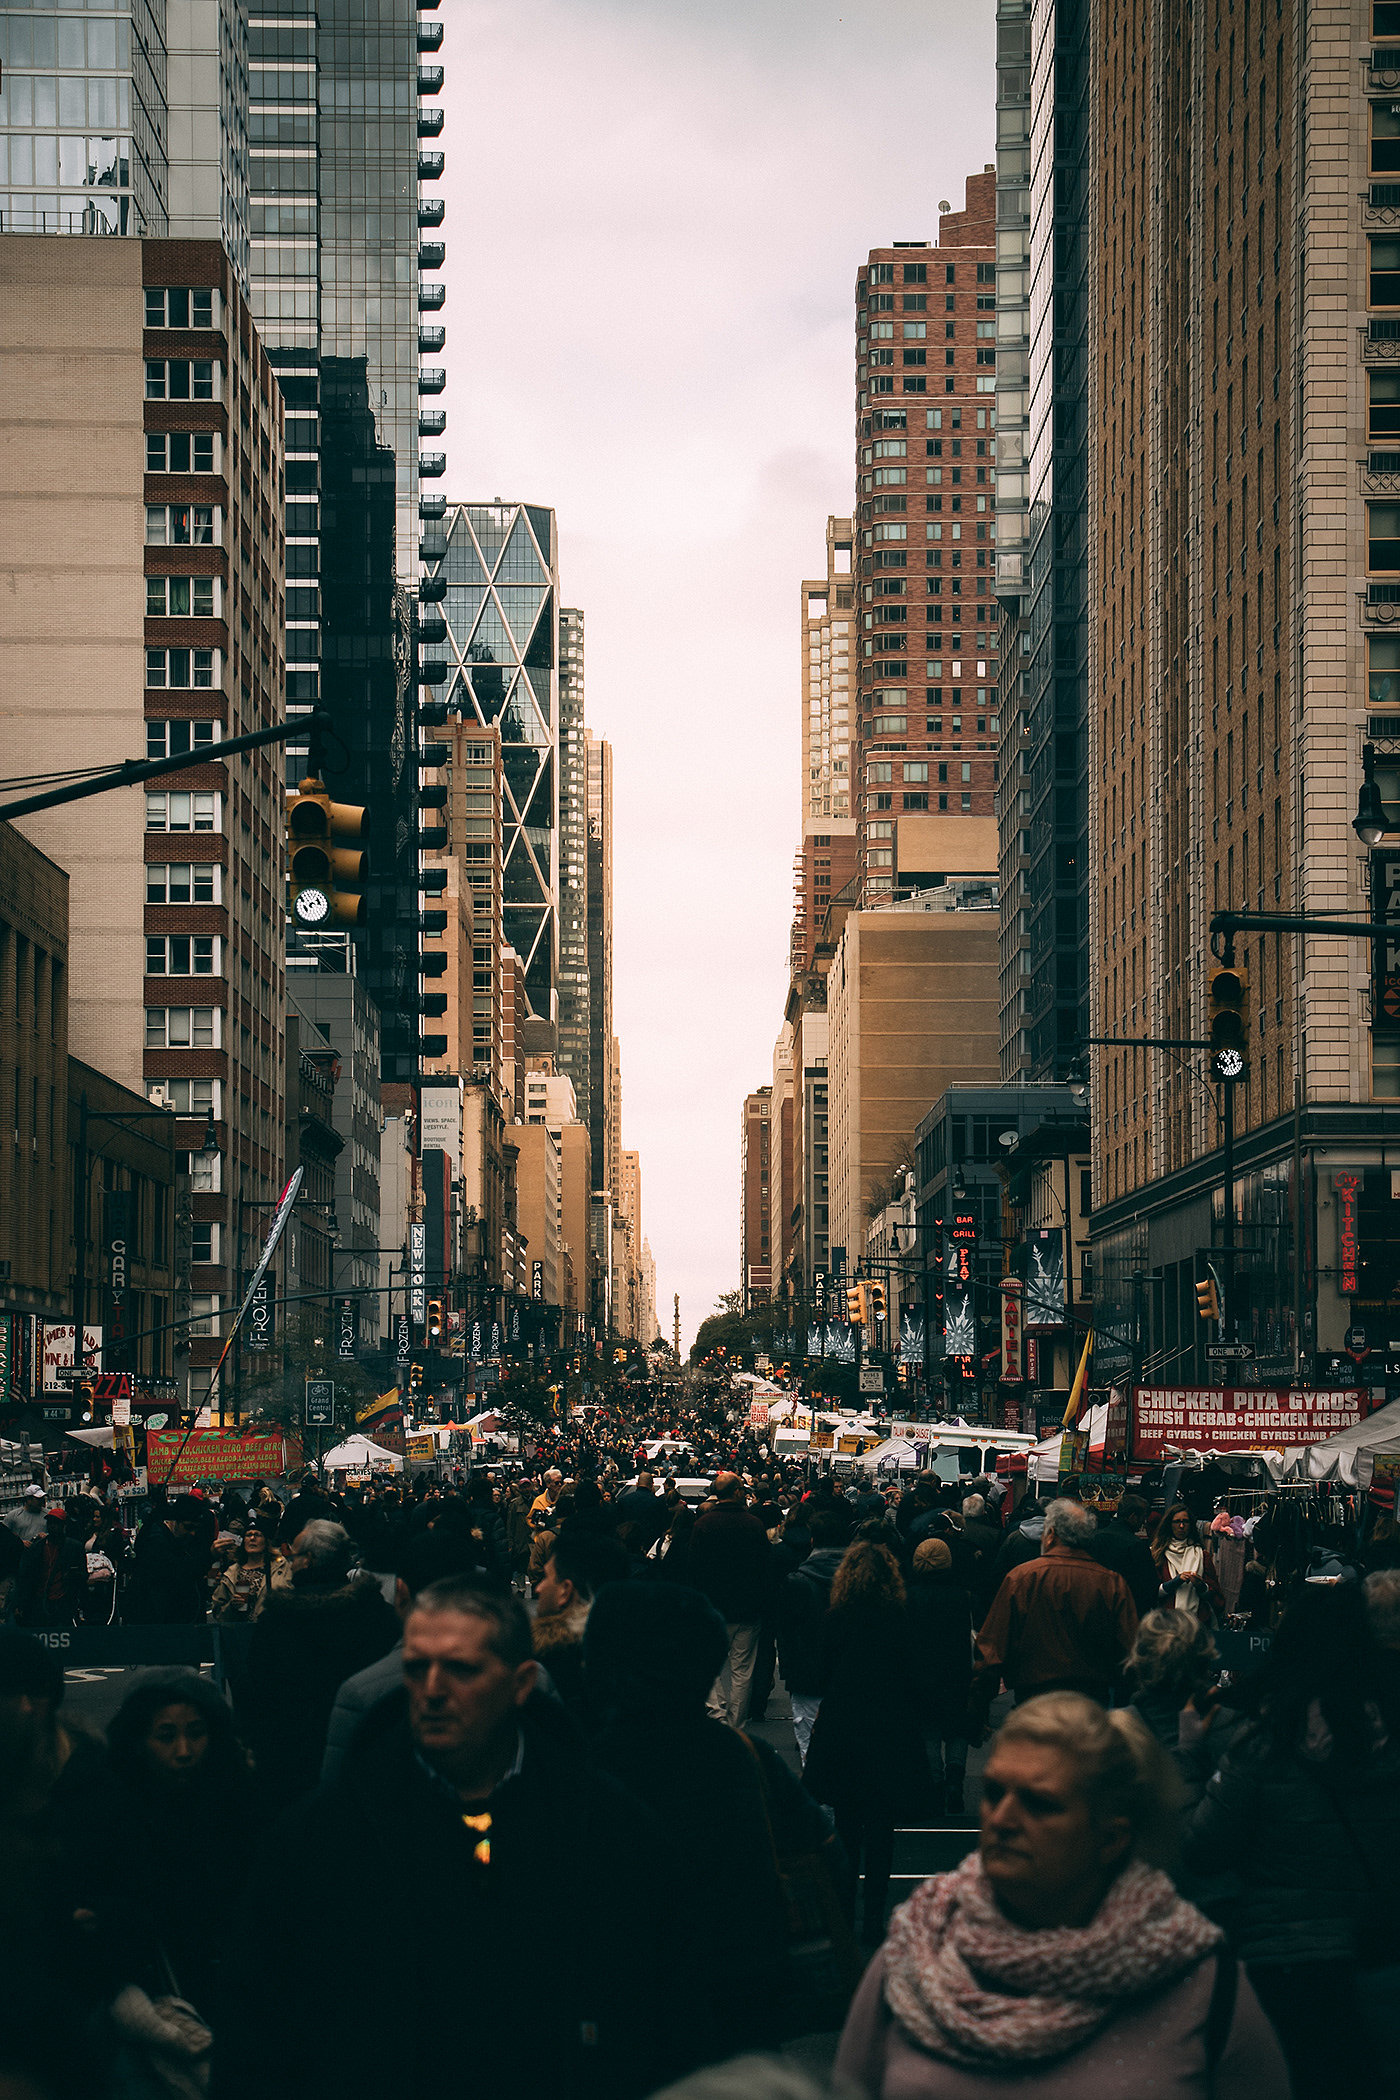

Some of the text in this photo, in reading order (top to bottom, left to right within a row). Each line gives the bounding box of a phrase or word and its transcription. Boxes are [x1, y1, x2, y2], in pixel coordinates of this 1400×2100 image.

[1385, 862, 1400, 972] PAK
[1335, 1171, 1360, 1188] City
[956, 1216, 973, 1224] BAR
[413, 1226, 423, 1260] NEW
[953, 1230, 976, 1238] GRILL
[1341, 1188, 1356, 1291] KITCHEN
[413, 1265, 423, 1307] YORK
[250, 1279, 269, 1344] FROZEN
[339, 1307, 355, 1357] FROZEN
[397, 1321, 411, 1364] FROZEN
[472, 1325, 482, 1357] FROZEN
[1005, 1290, 1018, 1376] DANIELA
[45, 1353, 61, 1366] WINE
[81, 1370, 94, 1378] WAY
[95, 1376, 132, 1399] ZZA
[1138, 1390, 1359, 1411] CHICKEN PITA GYROS
[1139, 1410, 1360, 1427] SHISH KEBAB CHICKEN KEBAB
[1140, 1429, 1163, 1439] BEEF
[1166, 1430, 1202, 1440] GYROS
[1211, 1430, 1257, 1440] CHICKEN
[1260, 1431, 1296, 1440] GYROS
[1297, 1431, 1327, 1441] LAMB
[150, 1446, 170, 1457] LAMB
[245, 1442, 262, 1451] BEEF
[264, 1441, 282, 1451] GYRO
[183, 1472, 217, 1480] COLD
[132, 1487, 146, 1495] $20
